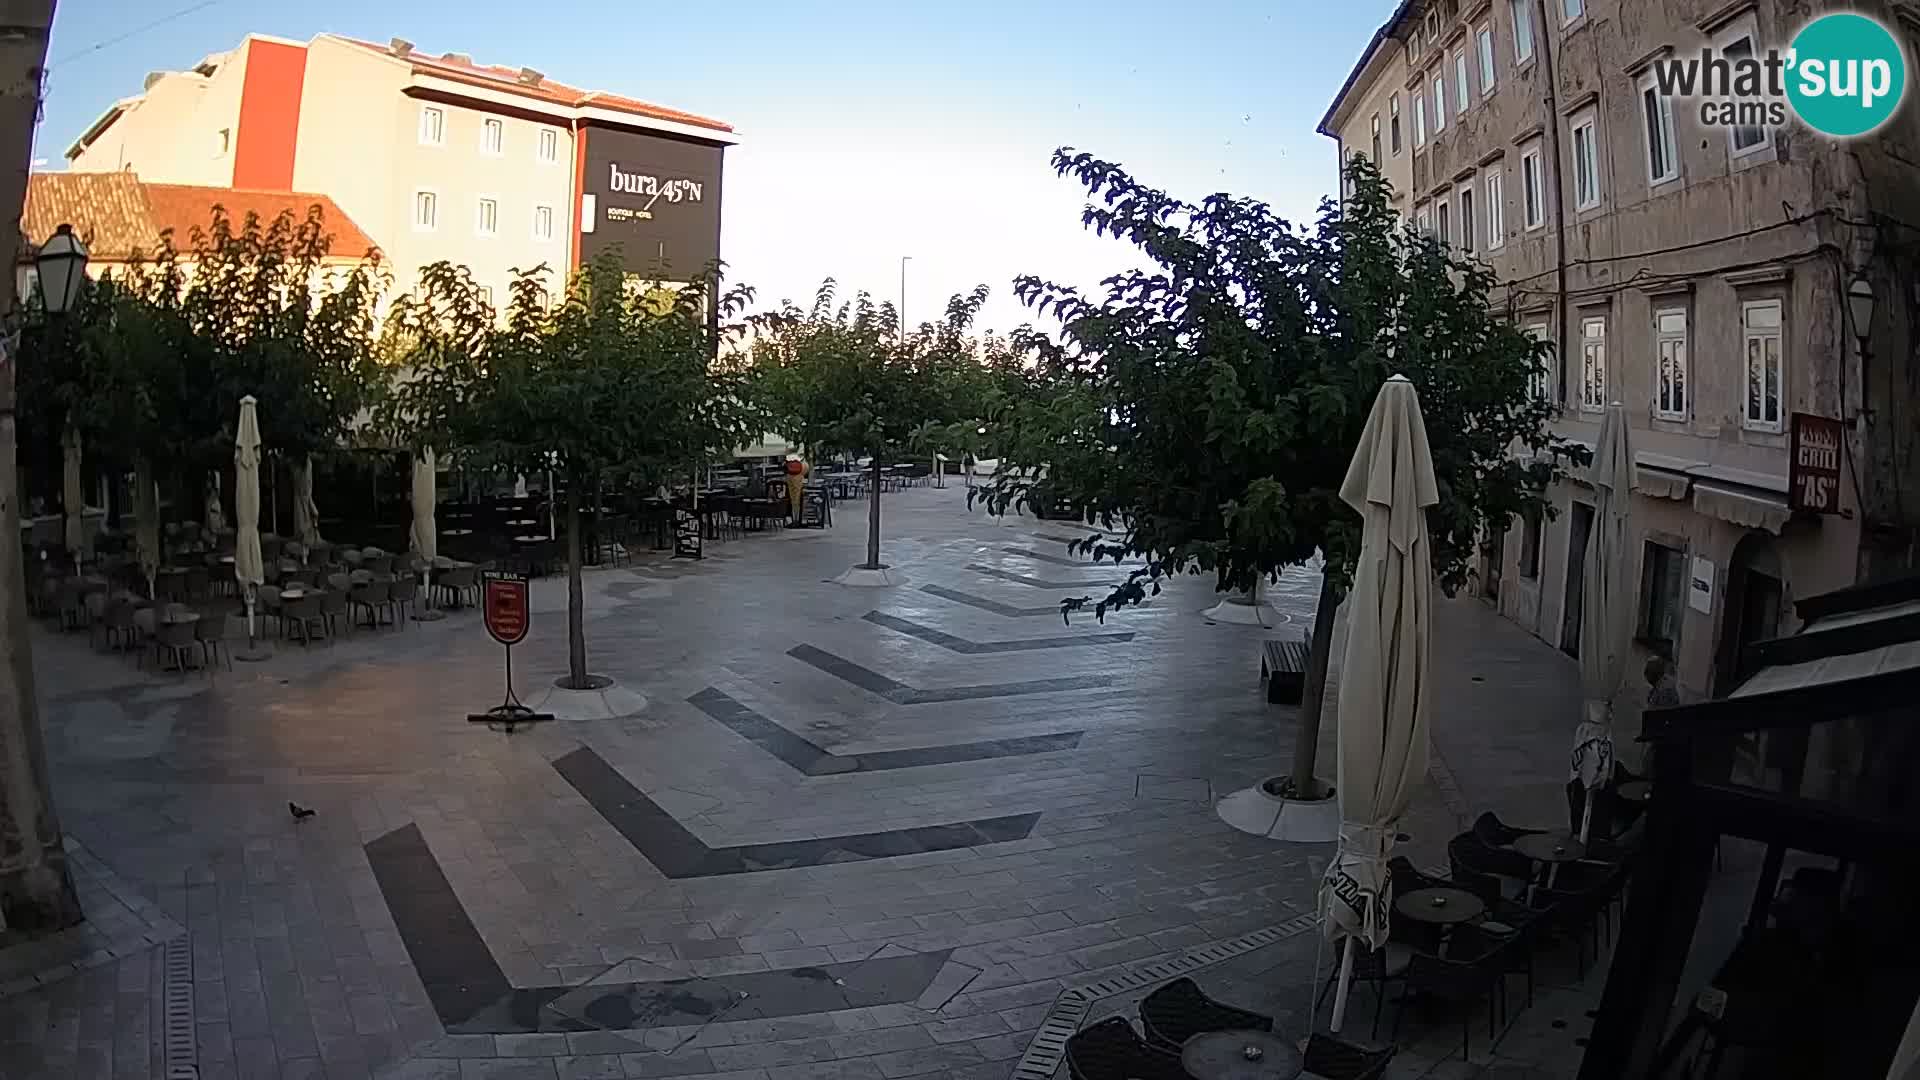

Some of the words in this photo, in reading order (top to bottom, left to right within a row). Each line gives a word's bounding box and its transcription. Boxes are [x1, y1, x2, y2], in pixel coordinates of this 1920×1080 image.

[635, 210, 652, 219] HOTEL
[1798, 446, 1837, 470] GRILL
[503, 572, 518, 580] BAR
